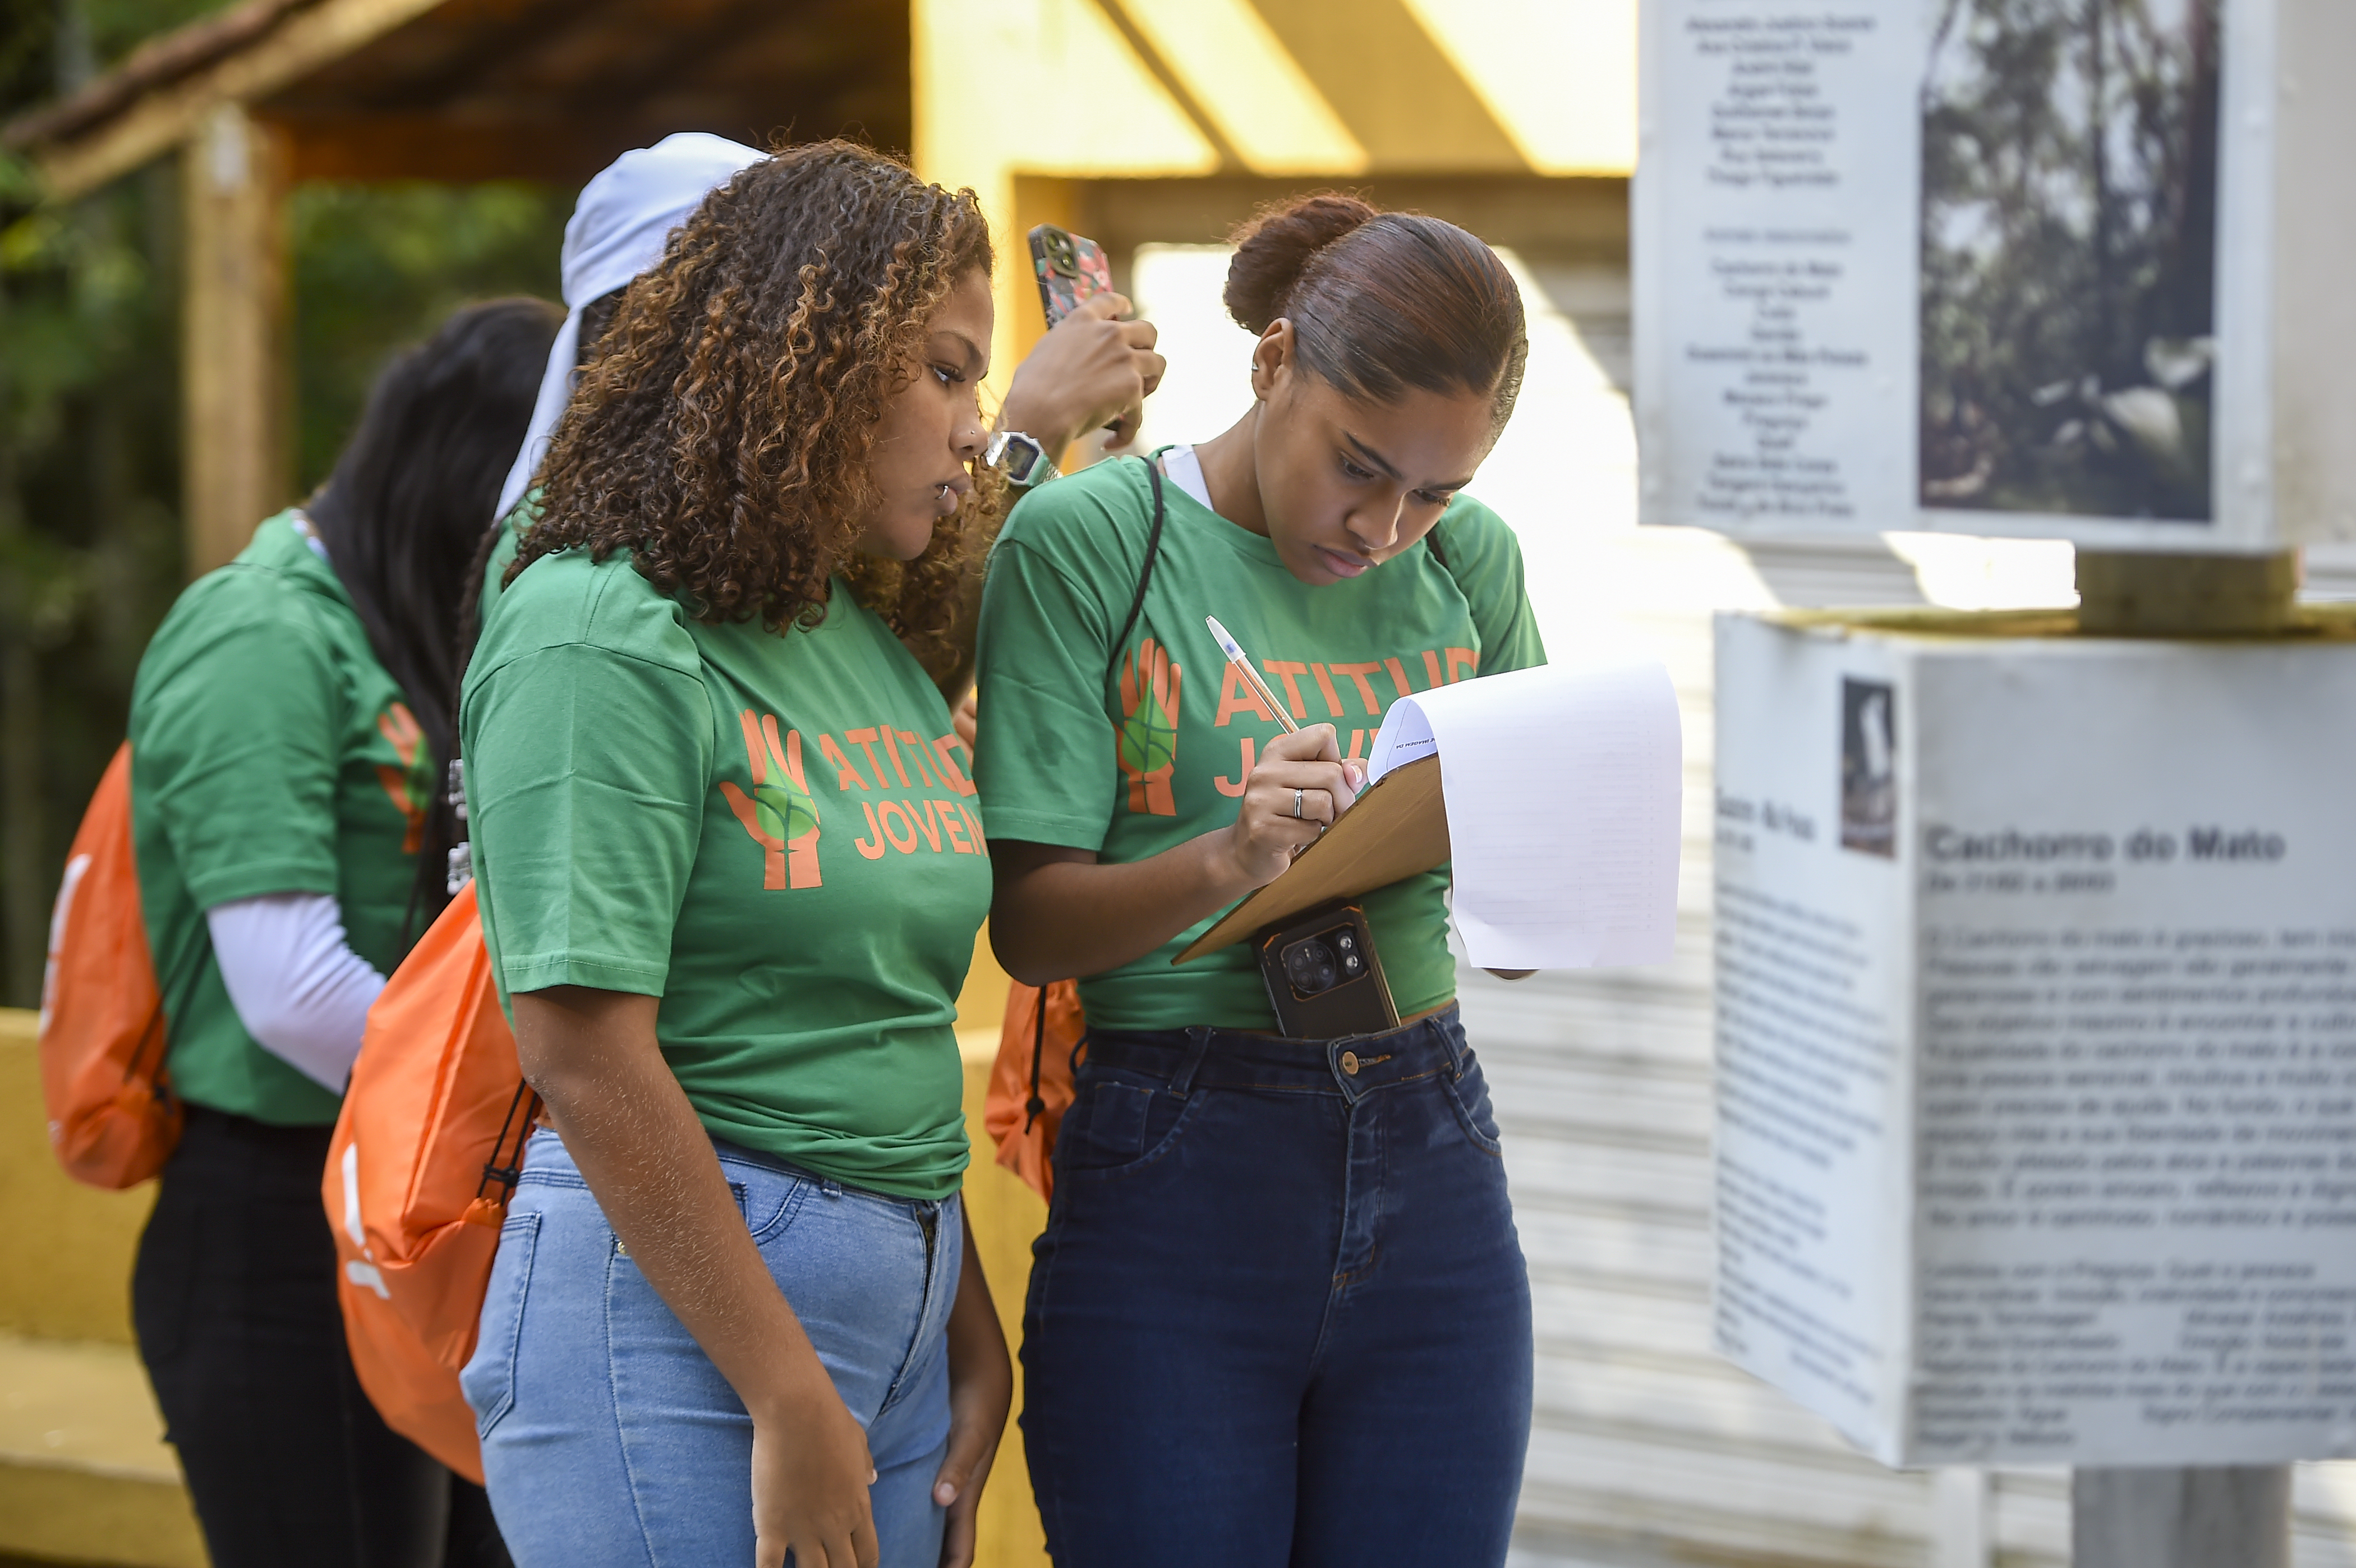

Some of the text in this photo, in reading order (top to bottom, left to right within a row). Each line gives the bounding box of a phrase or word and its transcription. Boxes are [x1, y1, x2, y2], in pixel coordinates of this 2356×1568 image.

[1405, 739, 1429, 747] IMAGEM
[1927, 825, 2286, 863] Cachorro do Mato
